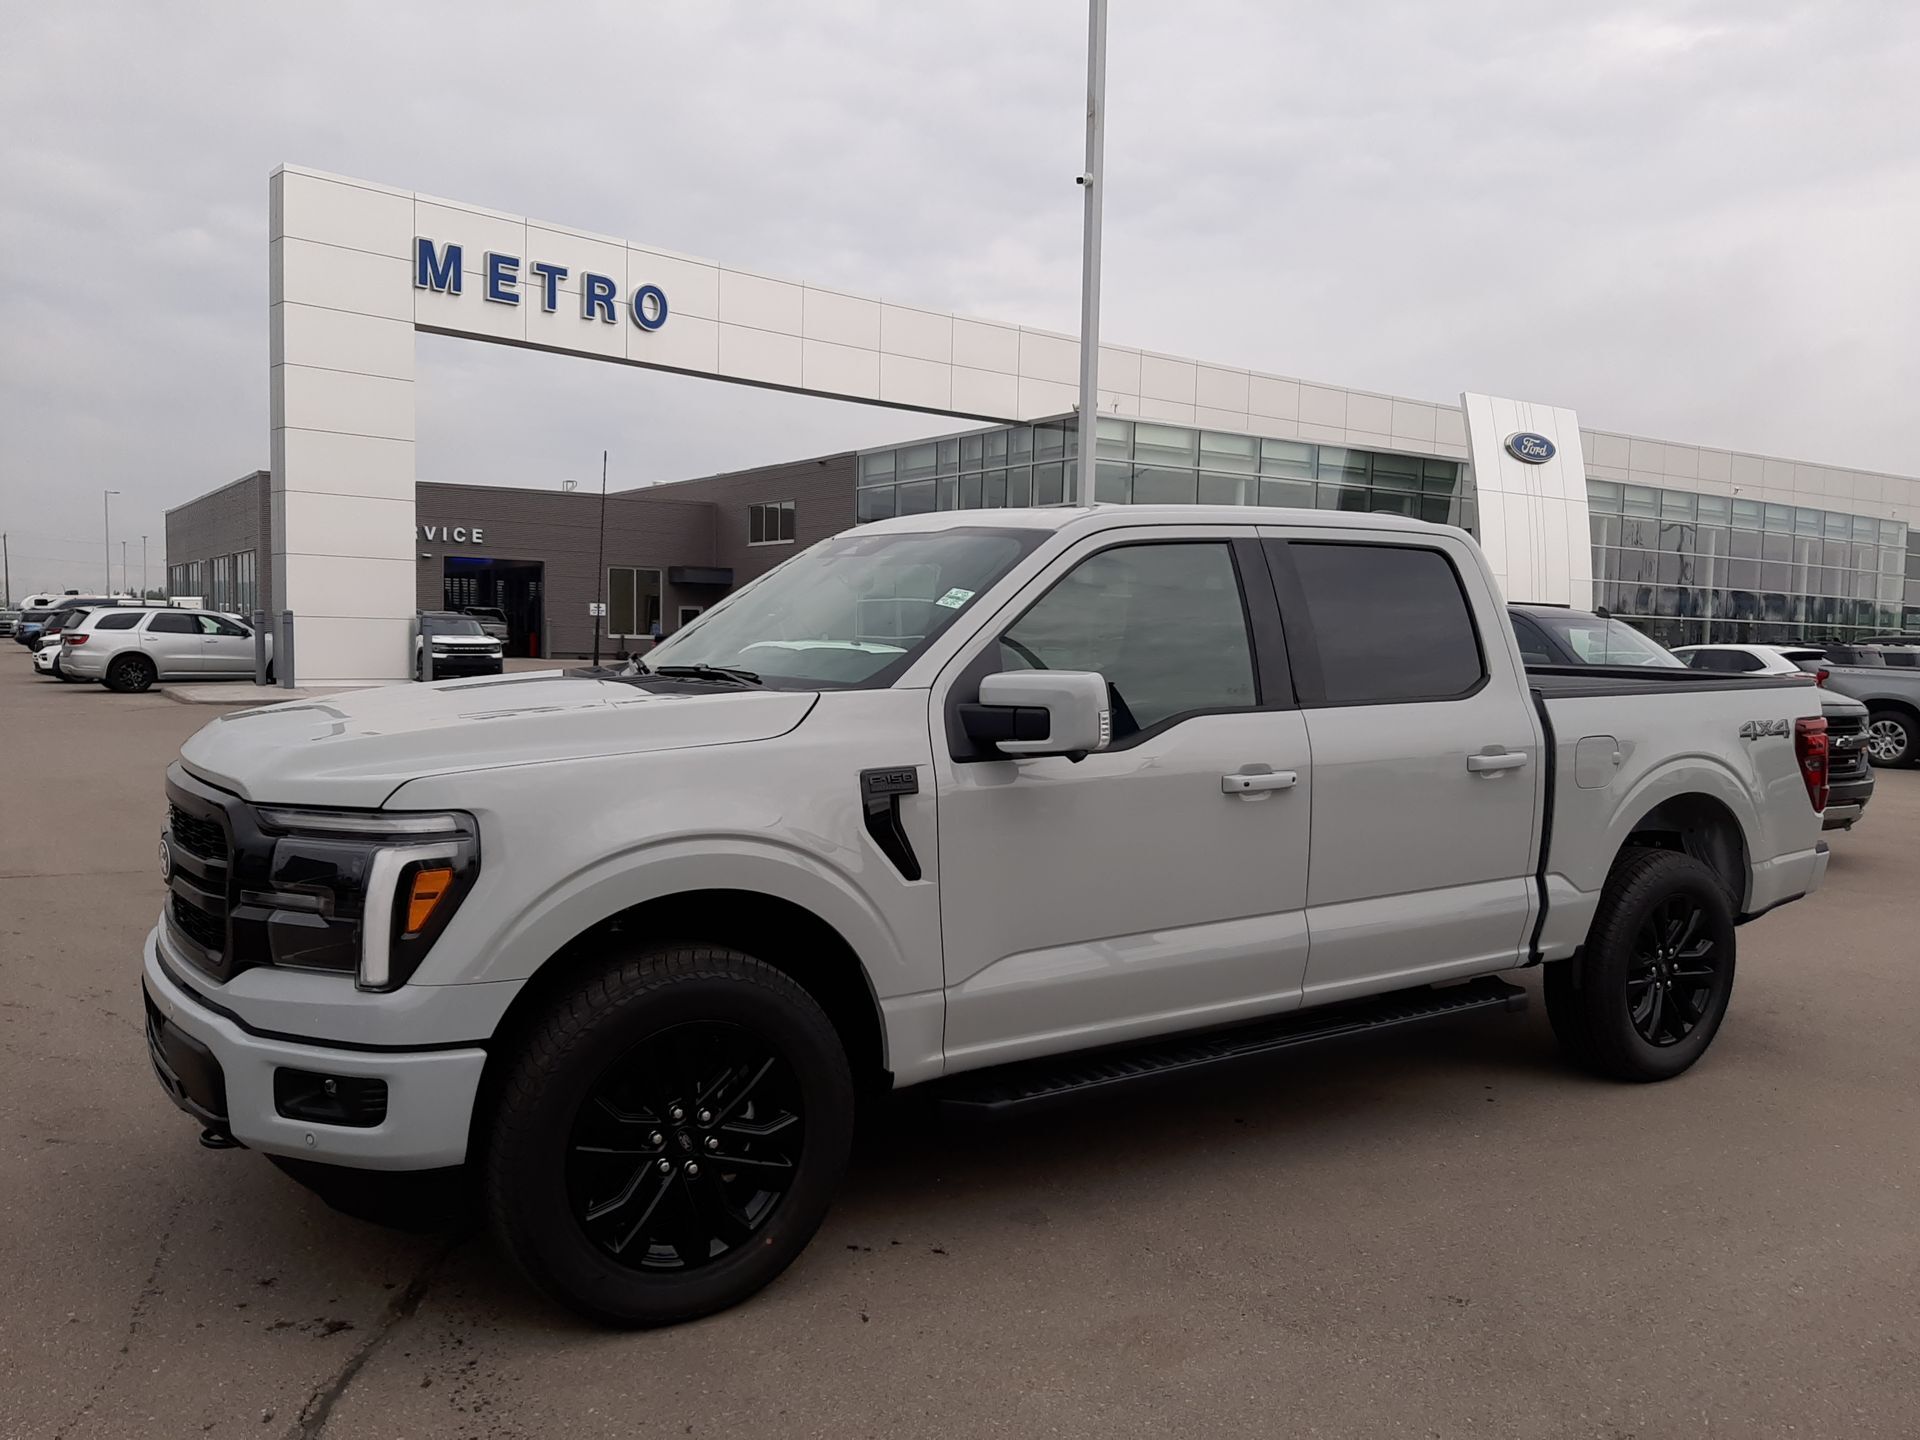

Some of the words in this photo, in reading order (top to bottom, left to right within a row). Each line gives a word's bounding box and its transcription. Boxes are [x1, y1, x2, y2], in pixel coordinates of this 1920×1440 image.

[415, 236, 669, 331] METRO
[1521, 437, 1547, 456] Ford
[416, 525, 484, 543] VICE
